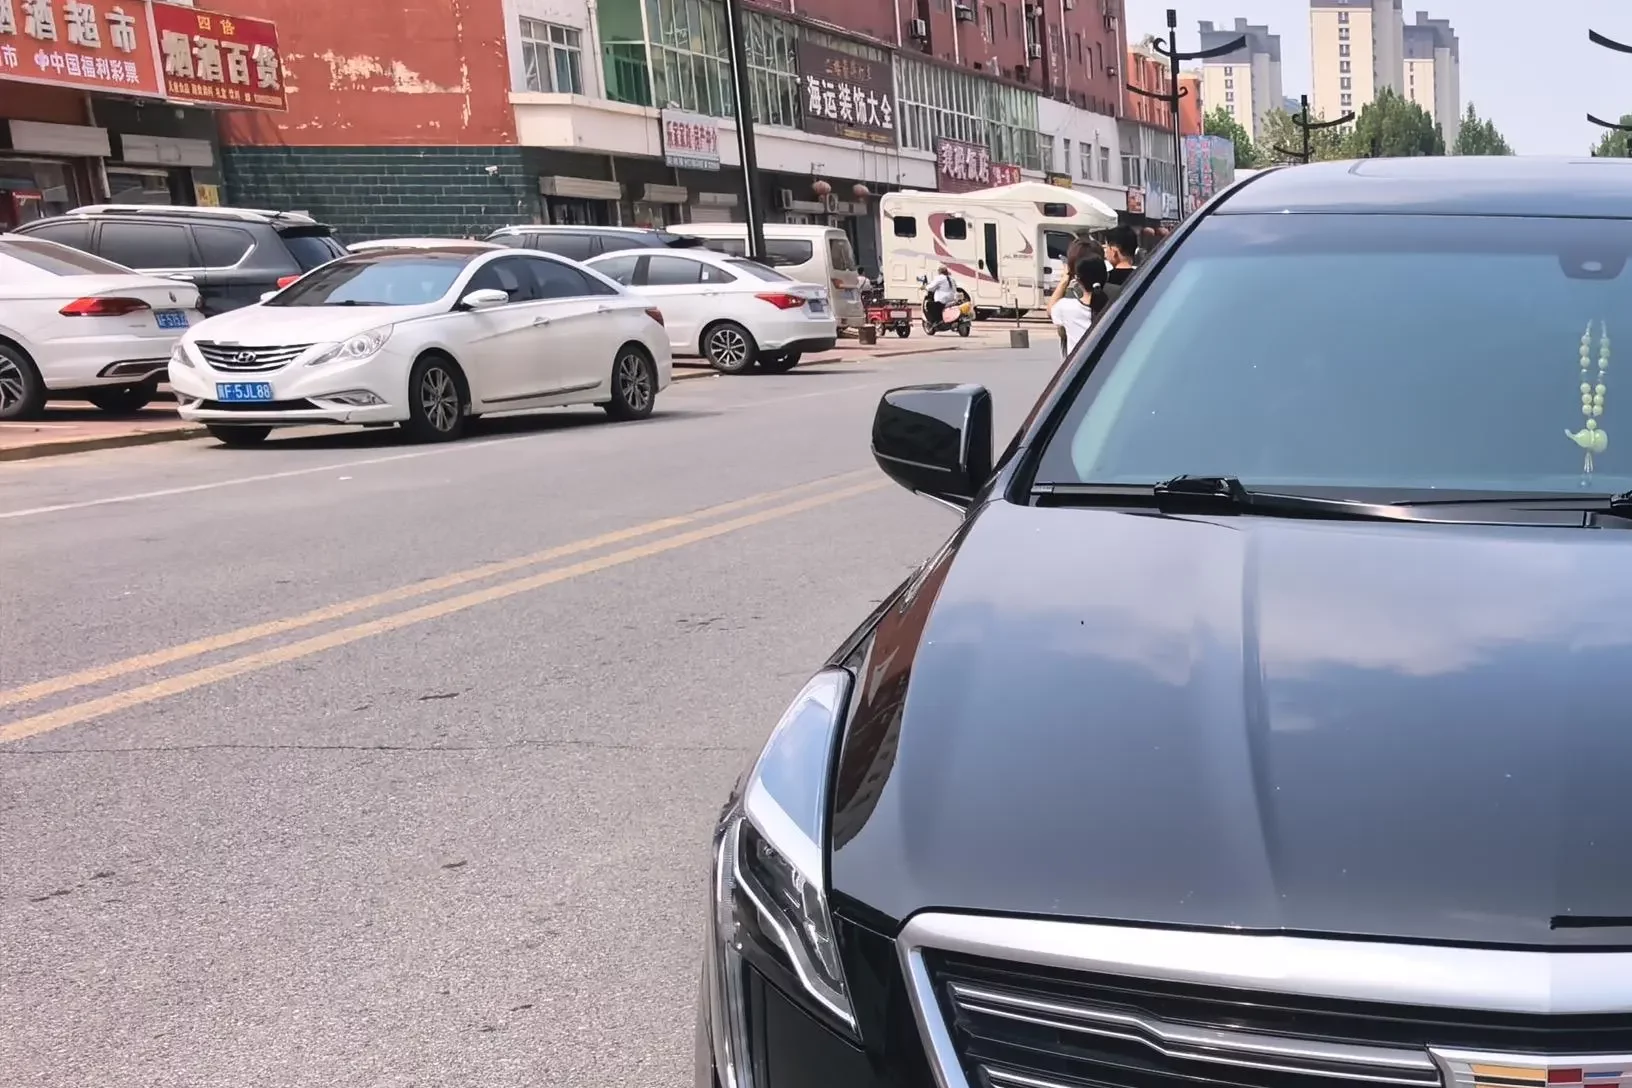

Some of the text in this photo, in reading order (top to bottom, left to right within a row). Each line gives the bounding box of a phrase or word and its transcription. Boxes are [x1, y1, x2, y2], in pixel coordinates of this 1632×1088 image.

[50, 51, 140, 83] 中国福利彩票
[161, 29, 280, 91] 烟酒百货
[806, 75, 893, 129] 海运装饰大全
